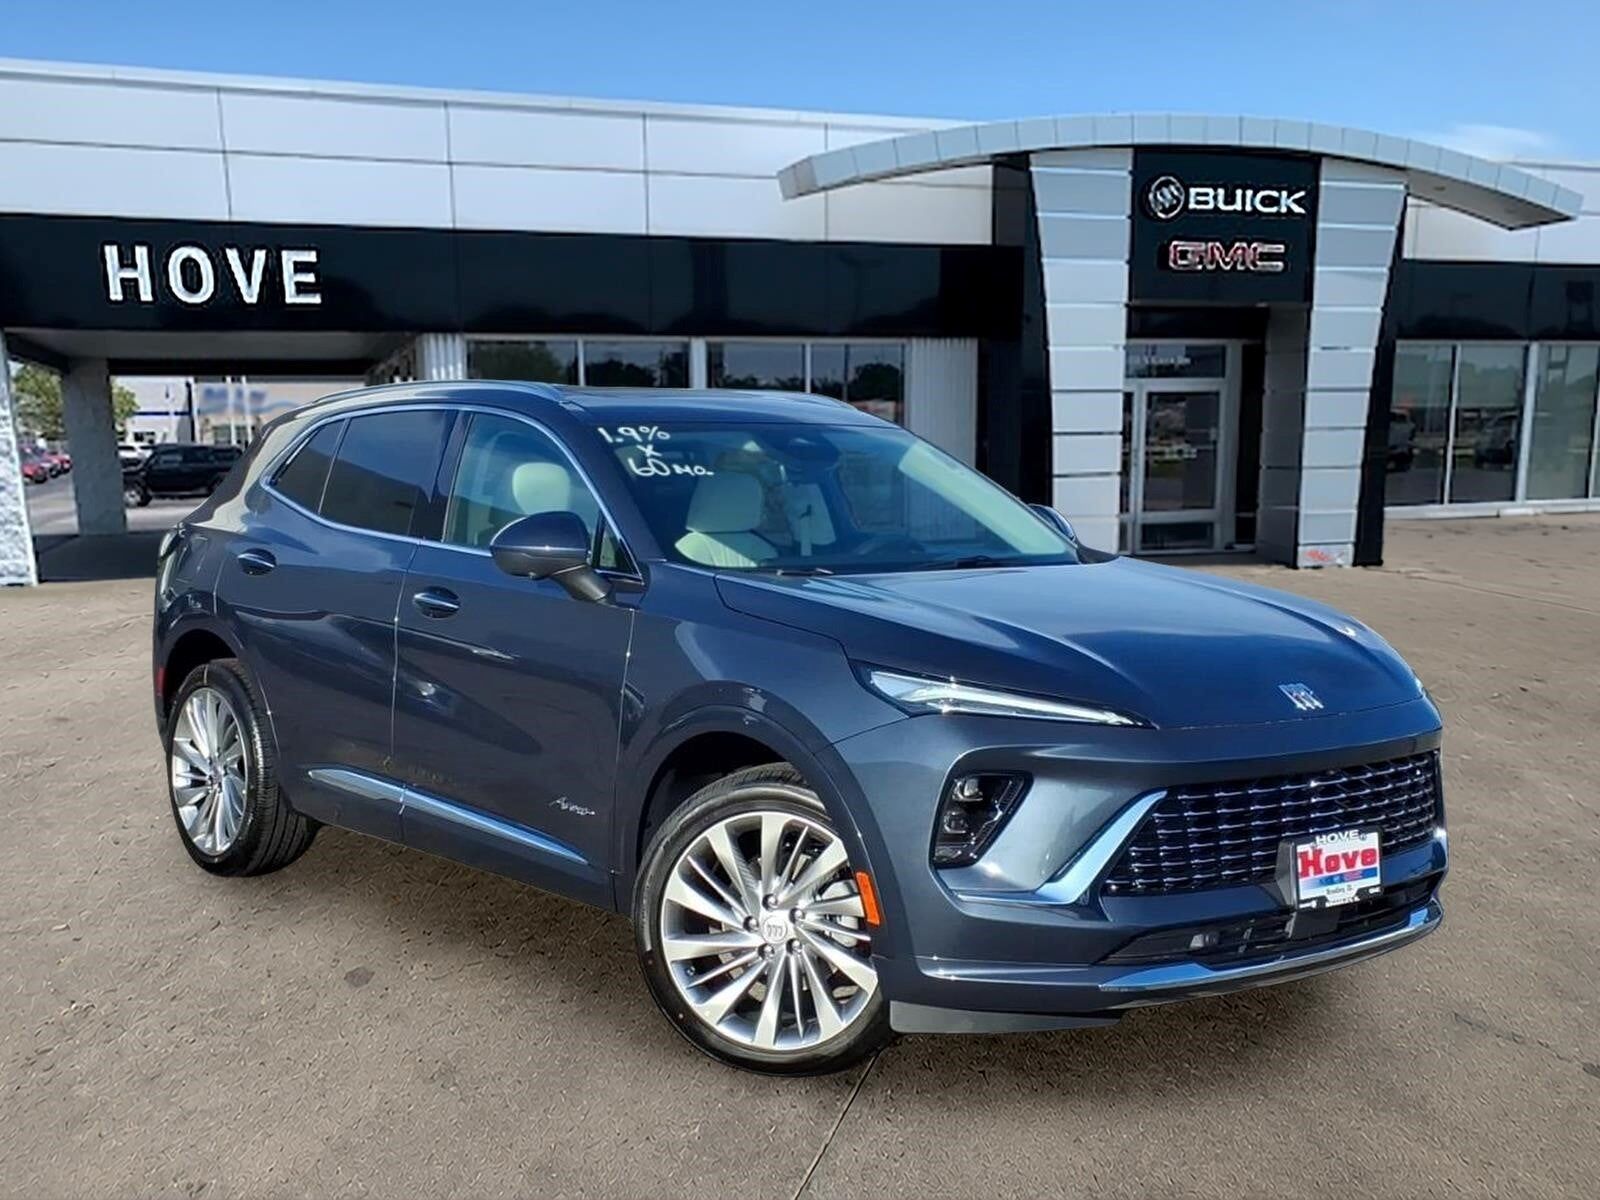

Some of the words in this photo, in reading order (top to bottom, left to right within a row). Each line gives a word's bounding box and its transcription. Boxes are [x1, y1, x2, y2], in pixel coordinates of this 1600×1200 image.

[1188, 187, 1306, 214] BUICK
[1169, 240, 1285, 271] GMC
[104, 245, 322, 304] HOVE
[598, 426, 671, 443] 1.9%
[627, 457, 671, 476] 60
[1316, 829, 1359, 844] HOVE
[1298, 848, 1377, 877] Hove
